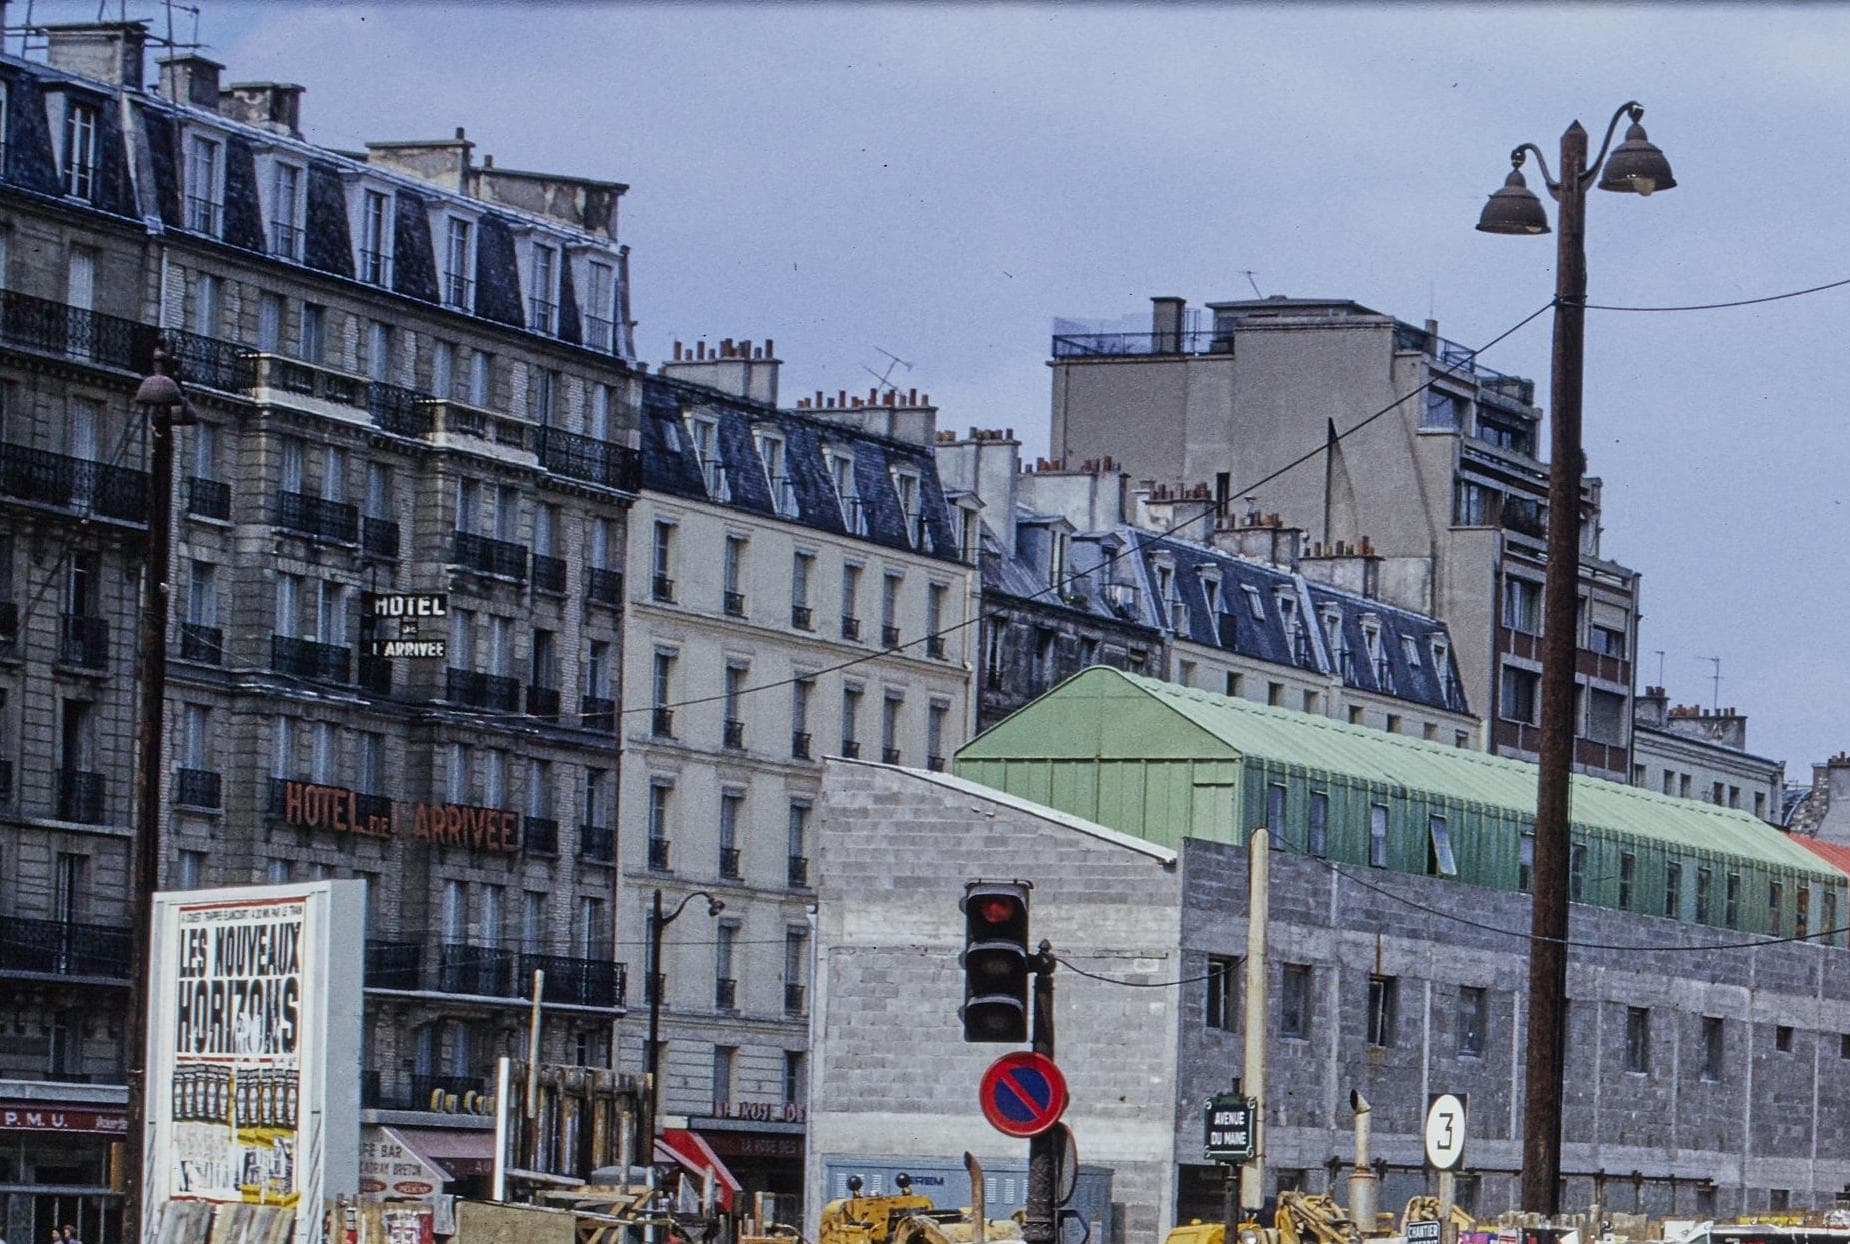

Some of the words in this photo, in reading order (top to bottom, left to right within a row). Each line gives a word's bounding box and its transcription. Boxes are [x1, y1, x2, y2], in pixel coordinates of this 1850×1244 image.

[374, 596, 446, 616] HOTEL
[286, 781, 365, 834] HOTEL
[179, 927, 208, 978] LES
[214, 921, 302, 978] NOUVEAUX
[176, 977, 299, 1055] HORIZONS
[1214, 1111, 1245, 1125] AVENUE
[1437, 1112, 1453, 1150] 3
[1210, 1131, 1222, 1145] DU
[1224, 1131, 1247, 1145] MAINE
[1409, 1224, 1438, 1239] CHANTIER
